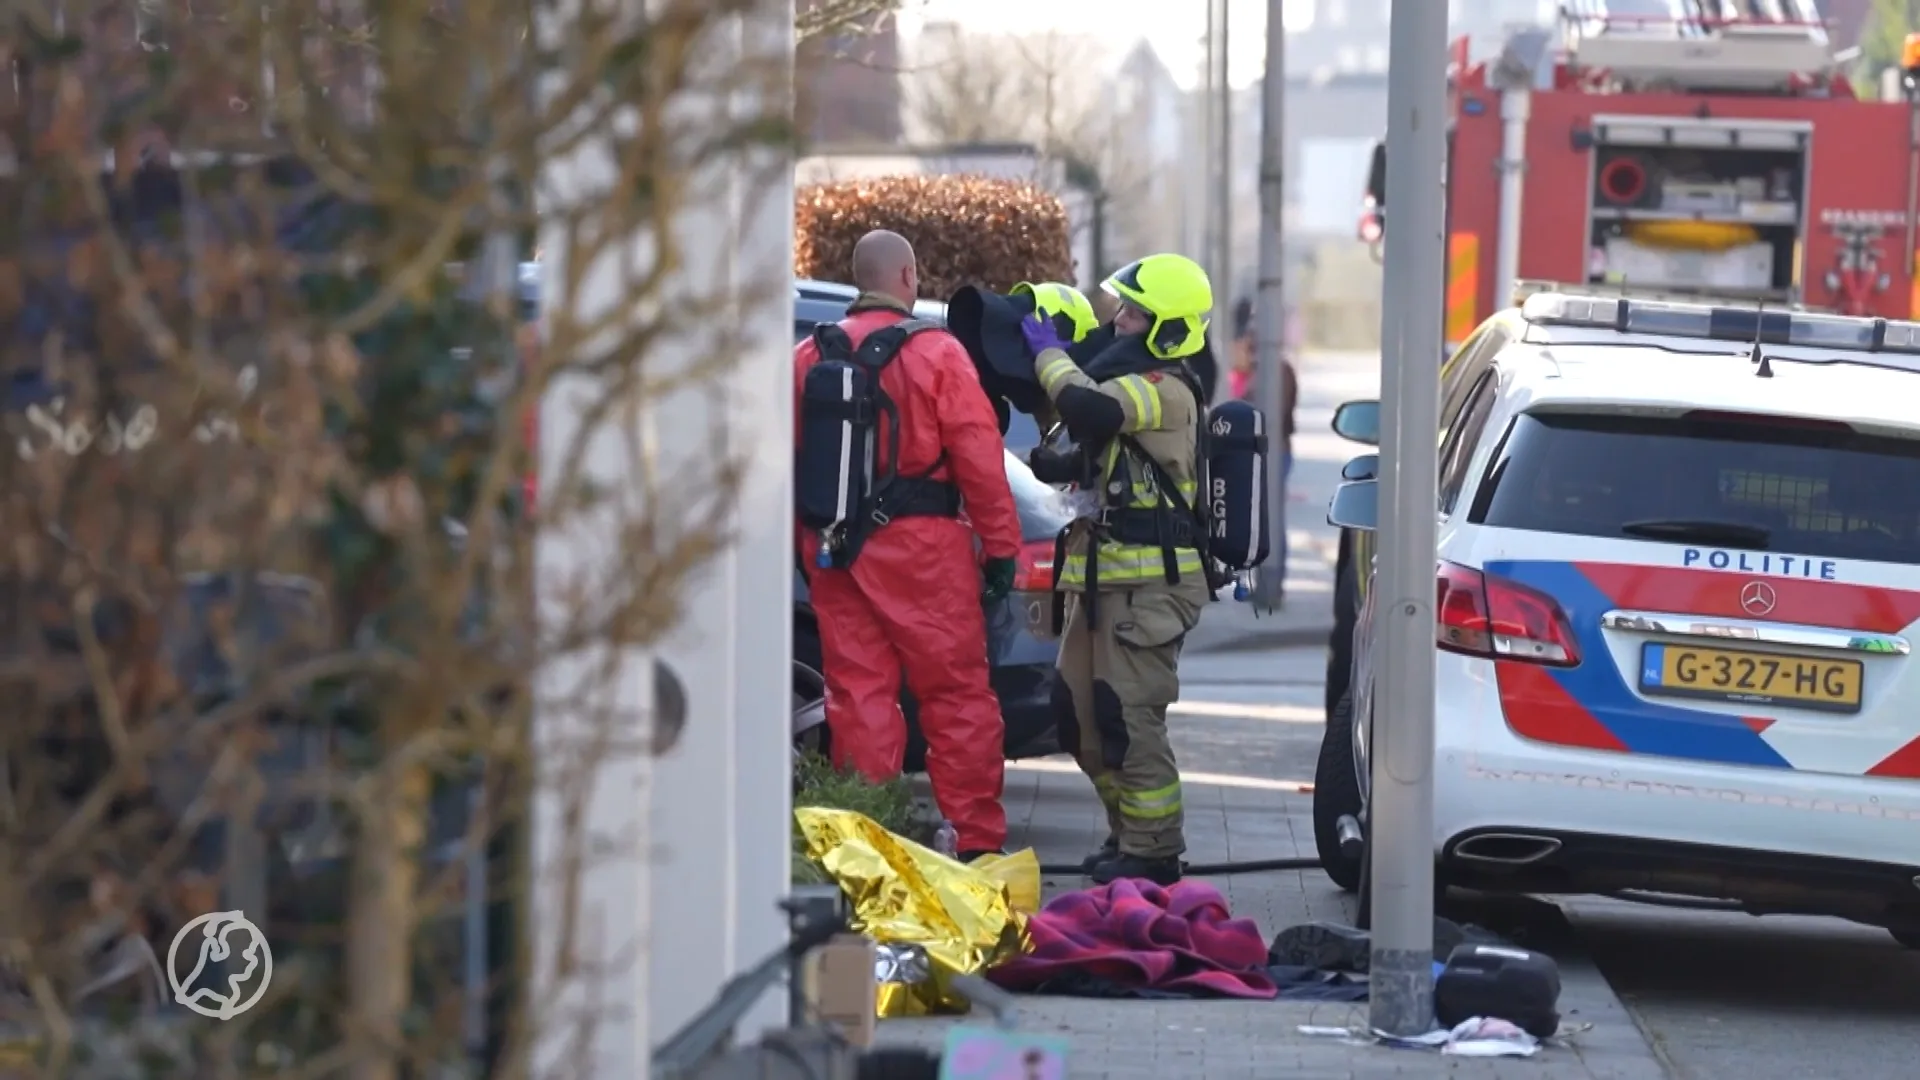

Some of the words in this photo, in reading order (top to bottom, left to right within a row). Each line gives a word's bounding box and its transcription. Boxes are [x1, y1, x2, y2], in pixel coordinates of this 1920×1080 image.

[1684, 549, 1836, 580] POLITIE
[1644, 668, 1660, 680] NL
[1675, 652, 1844, 697] G-327-HG
